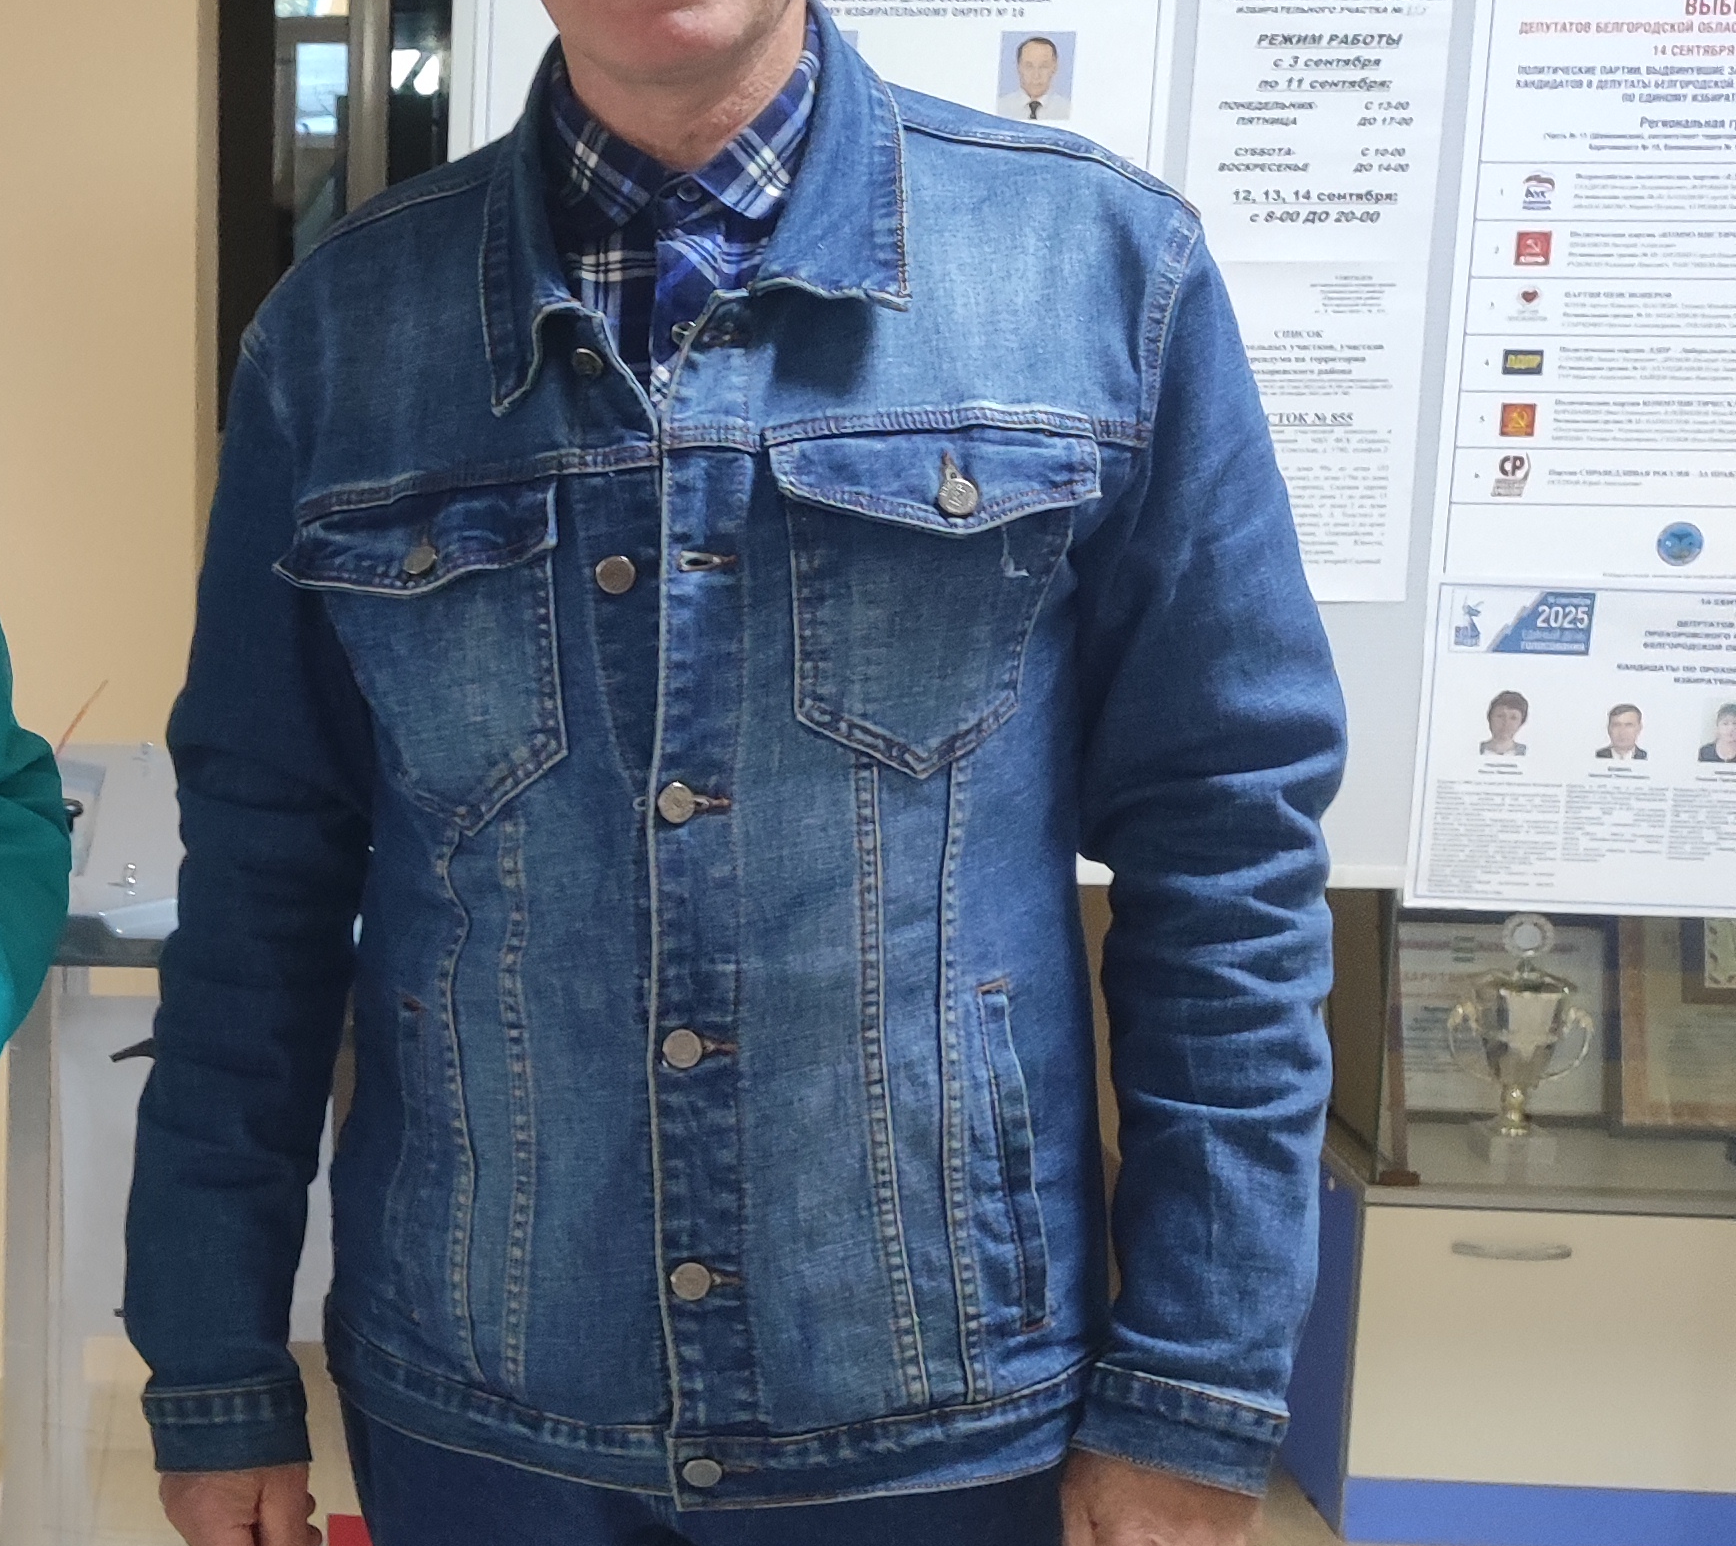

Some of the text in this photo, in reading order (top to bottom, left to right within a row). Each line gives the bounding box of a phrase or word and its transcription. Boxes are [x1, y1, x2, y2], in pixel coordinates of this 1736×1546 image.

[1519, 21, 1591, 35] ДЕПУТАТОВ
[1595, 20, 1694, 35] БЕЛГОРОДСКОЙ
[1256, 33, 1403, 46] РЕЖИМ РАБОТЫ
[1288, 56, 1300, 68] 3
[1304, 56, 1382, 70] сентября
[1257, 79, 1279, 91] по
[1286, 77, 1304, 89] 11
[1292, 189, 1311, 202] 14
[1317, 188, 1398, 203] сентября:
[1263, 210, 1301, 223] 8-00
[1302, 210, 1330, 224] ДО
[1333, 210, 1381, 223] 20-00
[1536, 605, 1589, 629] 2025
